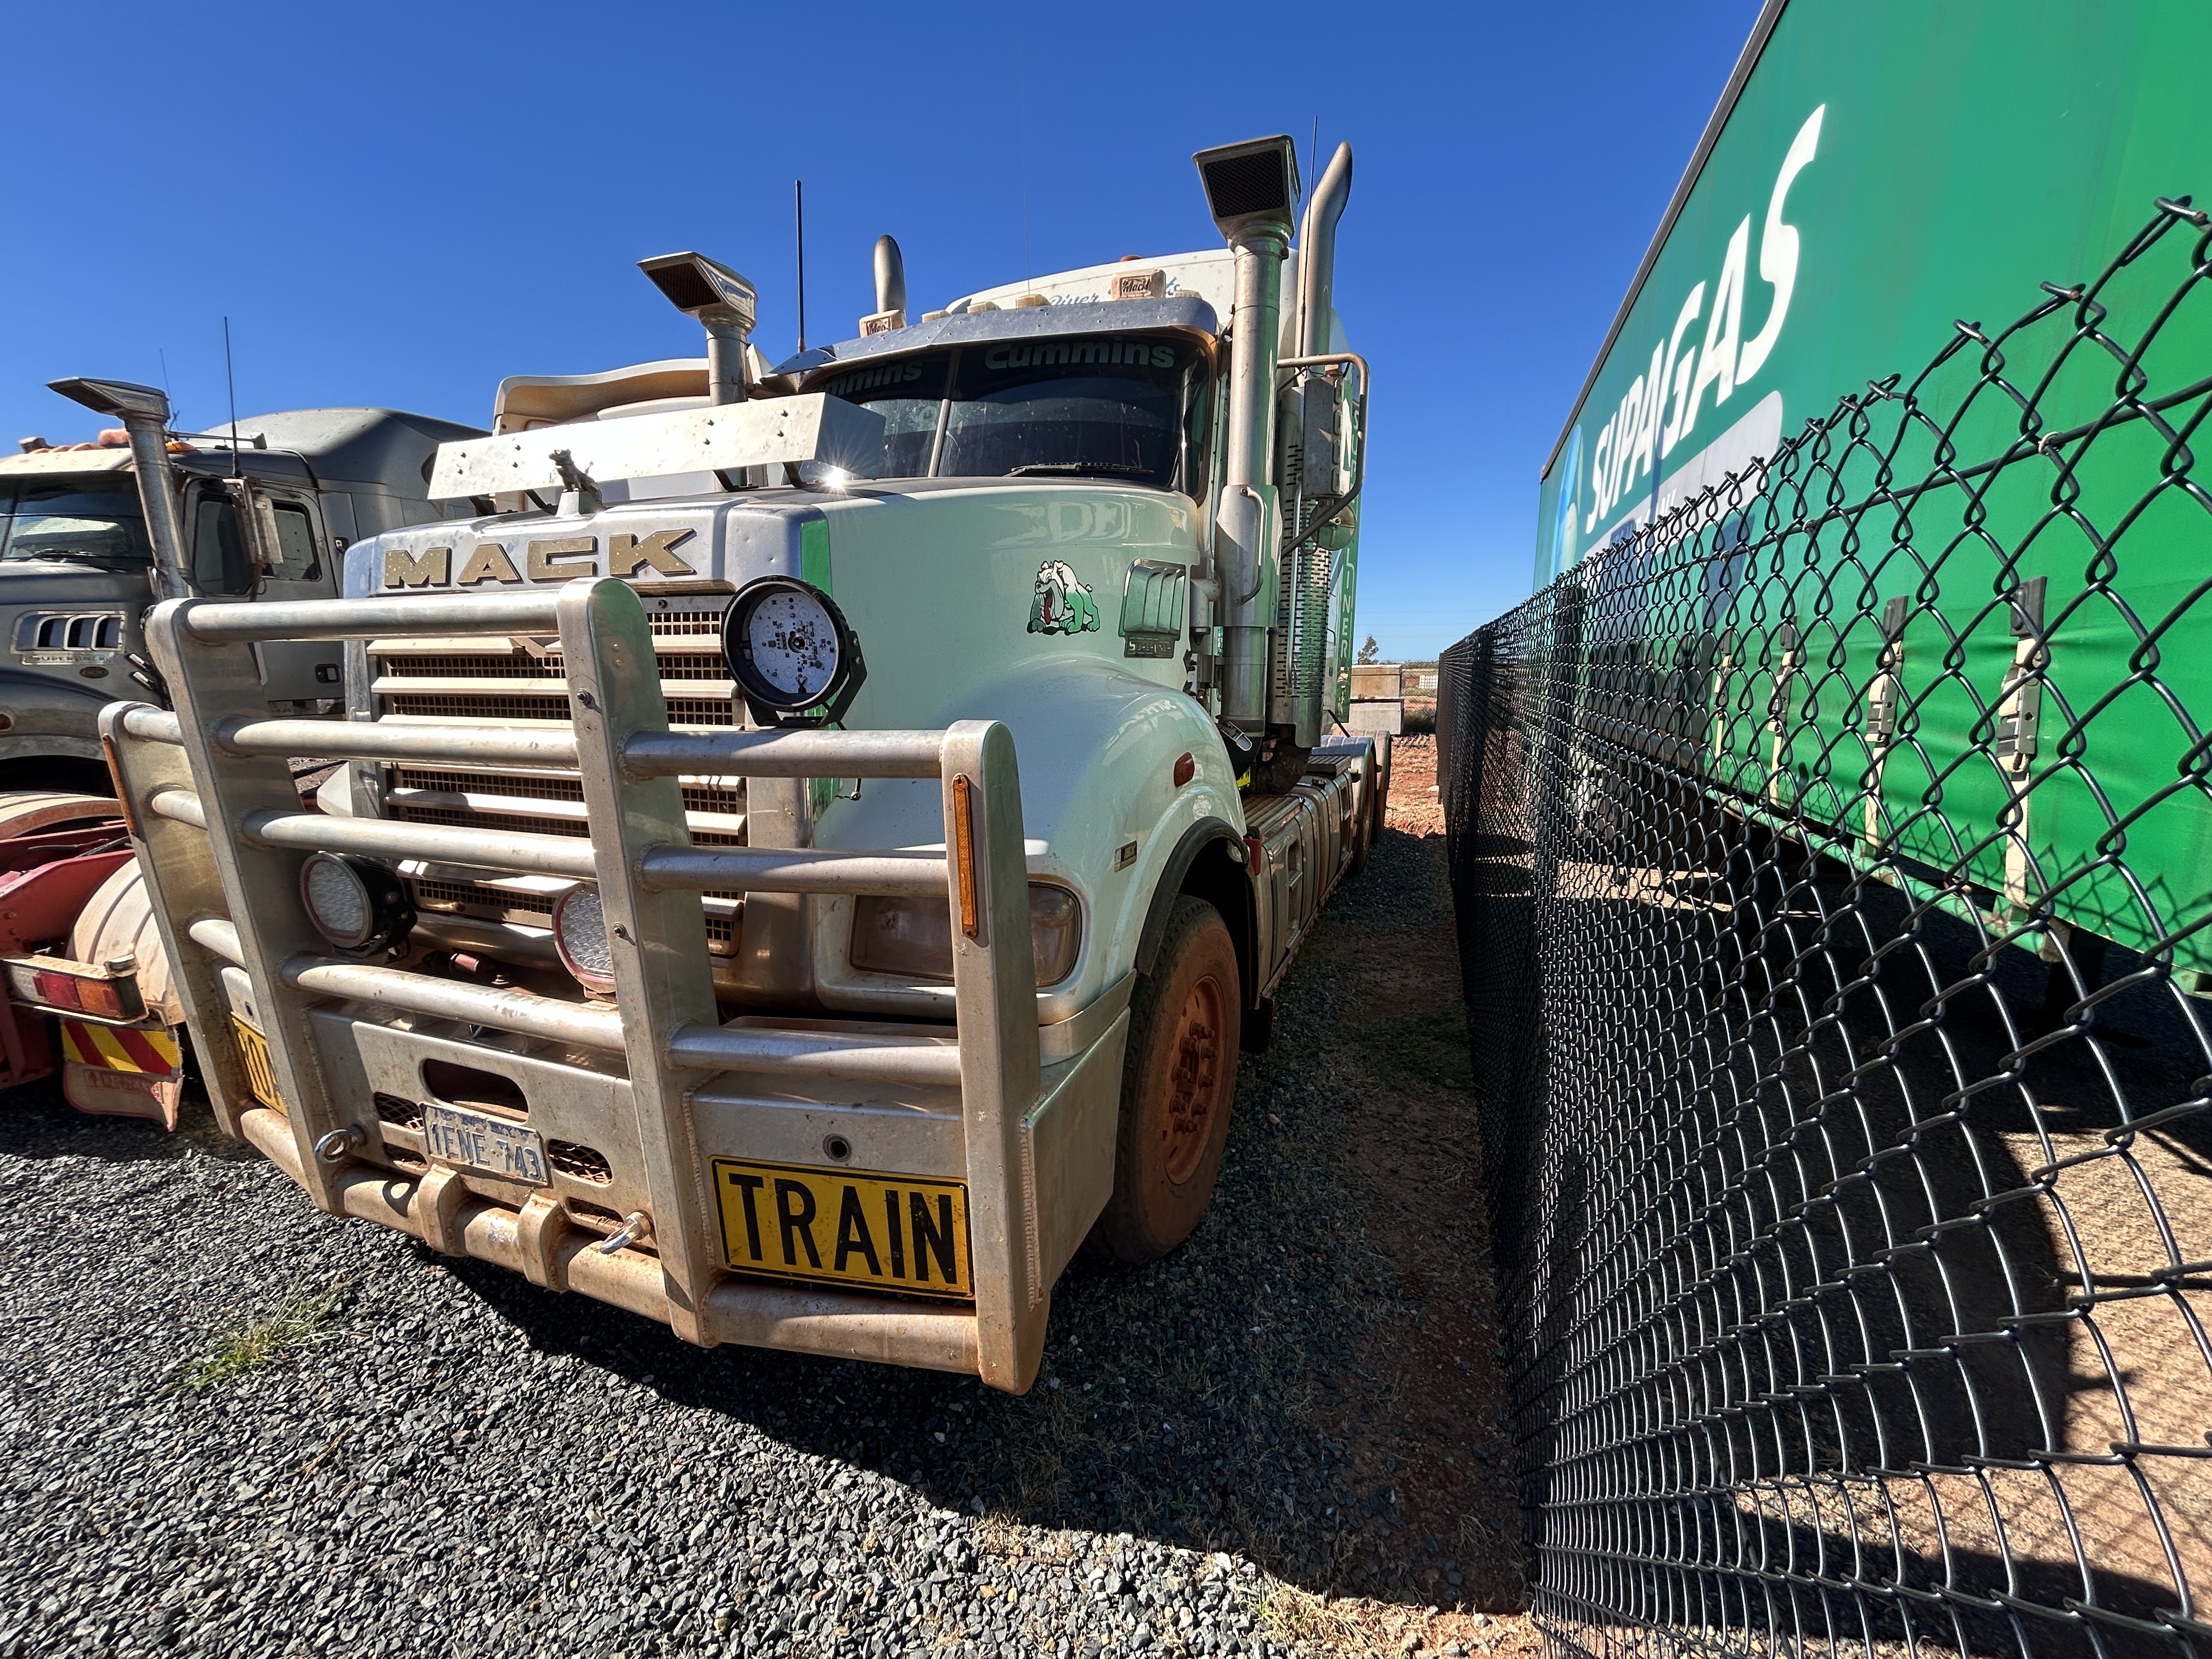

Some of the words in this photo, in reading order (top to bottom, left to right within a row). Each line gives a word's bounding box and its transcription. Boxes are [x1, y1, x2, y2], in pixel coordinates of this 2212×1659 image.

[985, 336, 1175, 369] Cummins
[1586, 104, 1826, 534] SUPAGAS
[384, 528, 697, 589] MACK
[234, 1024, 281, 1107] ROA
[432, 1122, 490, 1166] 1ENE
[495, 1138, 542, 1180] 743
[728, 1172, 958, 1284] TRAIN
